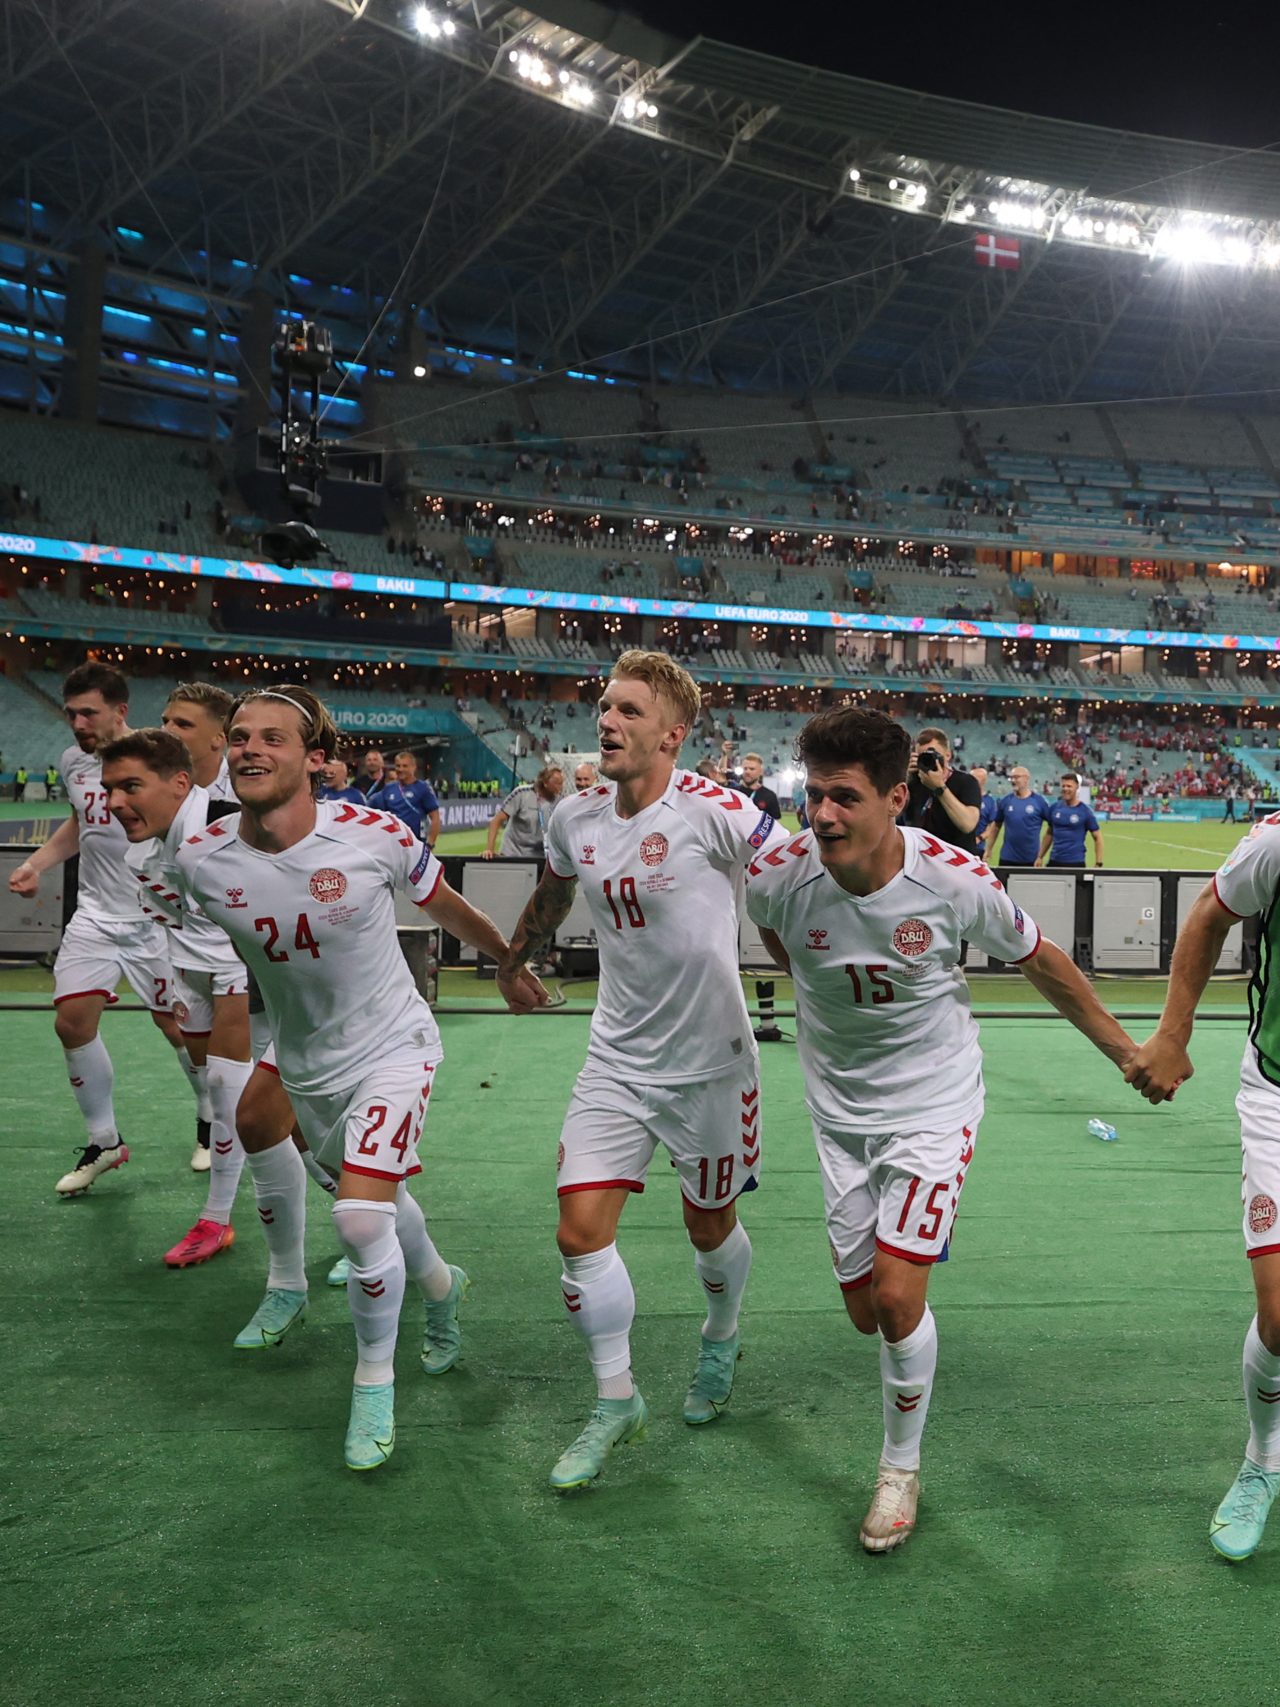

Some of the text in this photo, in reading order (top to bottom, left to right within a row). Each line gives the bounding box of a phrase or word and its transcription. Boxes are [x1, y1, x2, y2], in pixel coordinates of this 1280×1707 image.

[376, 577, 415, 593] BAKU
[715, 606, 808, 622] UEFA EURO 2020
[1050, 626, 1080, 639] BAKU
[331, 710, 408, 727] URO 2020
[84, 792, 110, 824] 23
[448, 805, 462, 826] AN
[316, 878, 340, 892] DBU
[603, 876, 646, 930] 18
[254, 913, 320, 962] 24
[901, 931, 924, 944] DBU
[845, 963, 895, 1004] 15
[358, 1105, 413, 1163] 24
[698, 1154, 734, 1201] 18
[896, 1176, 950, 1241] 15
[1252, 1206, 1270, 1221] DBU
